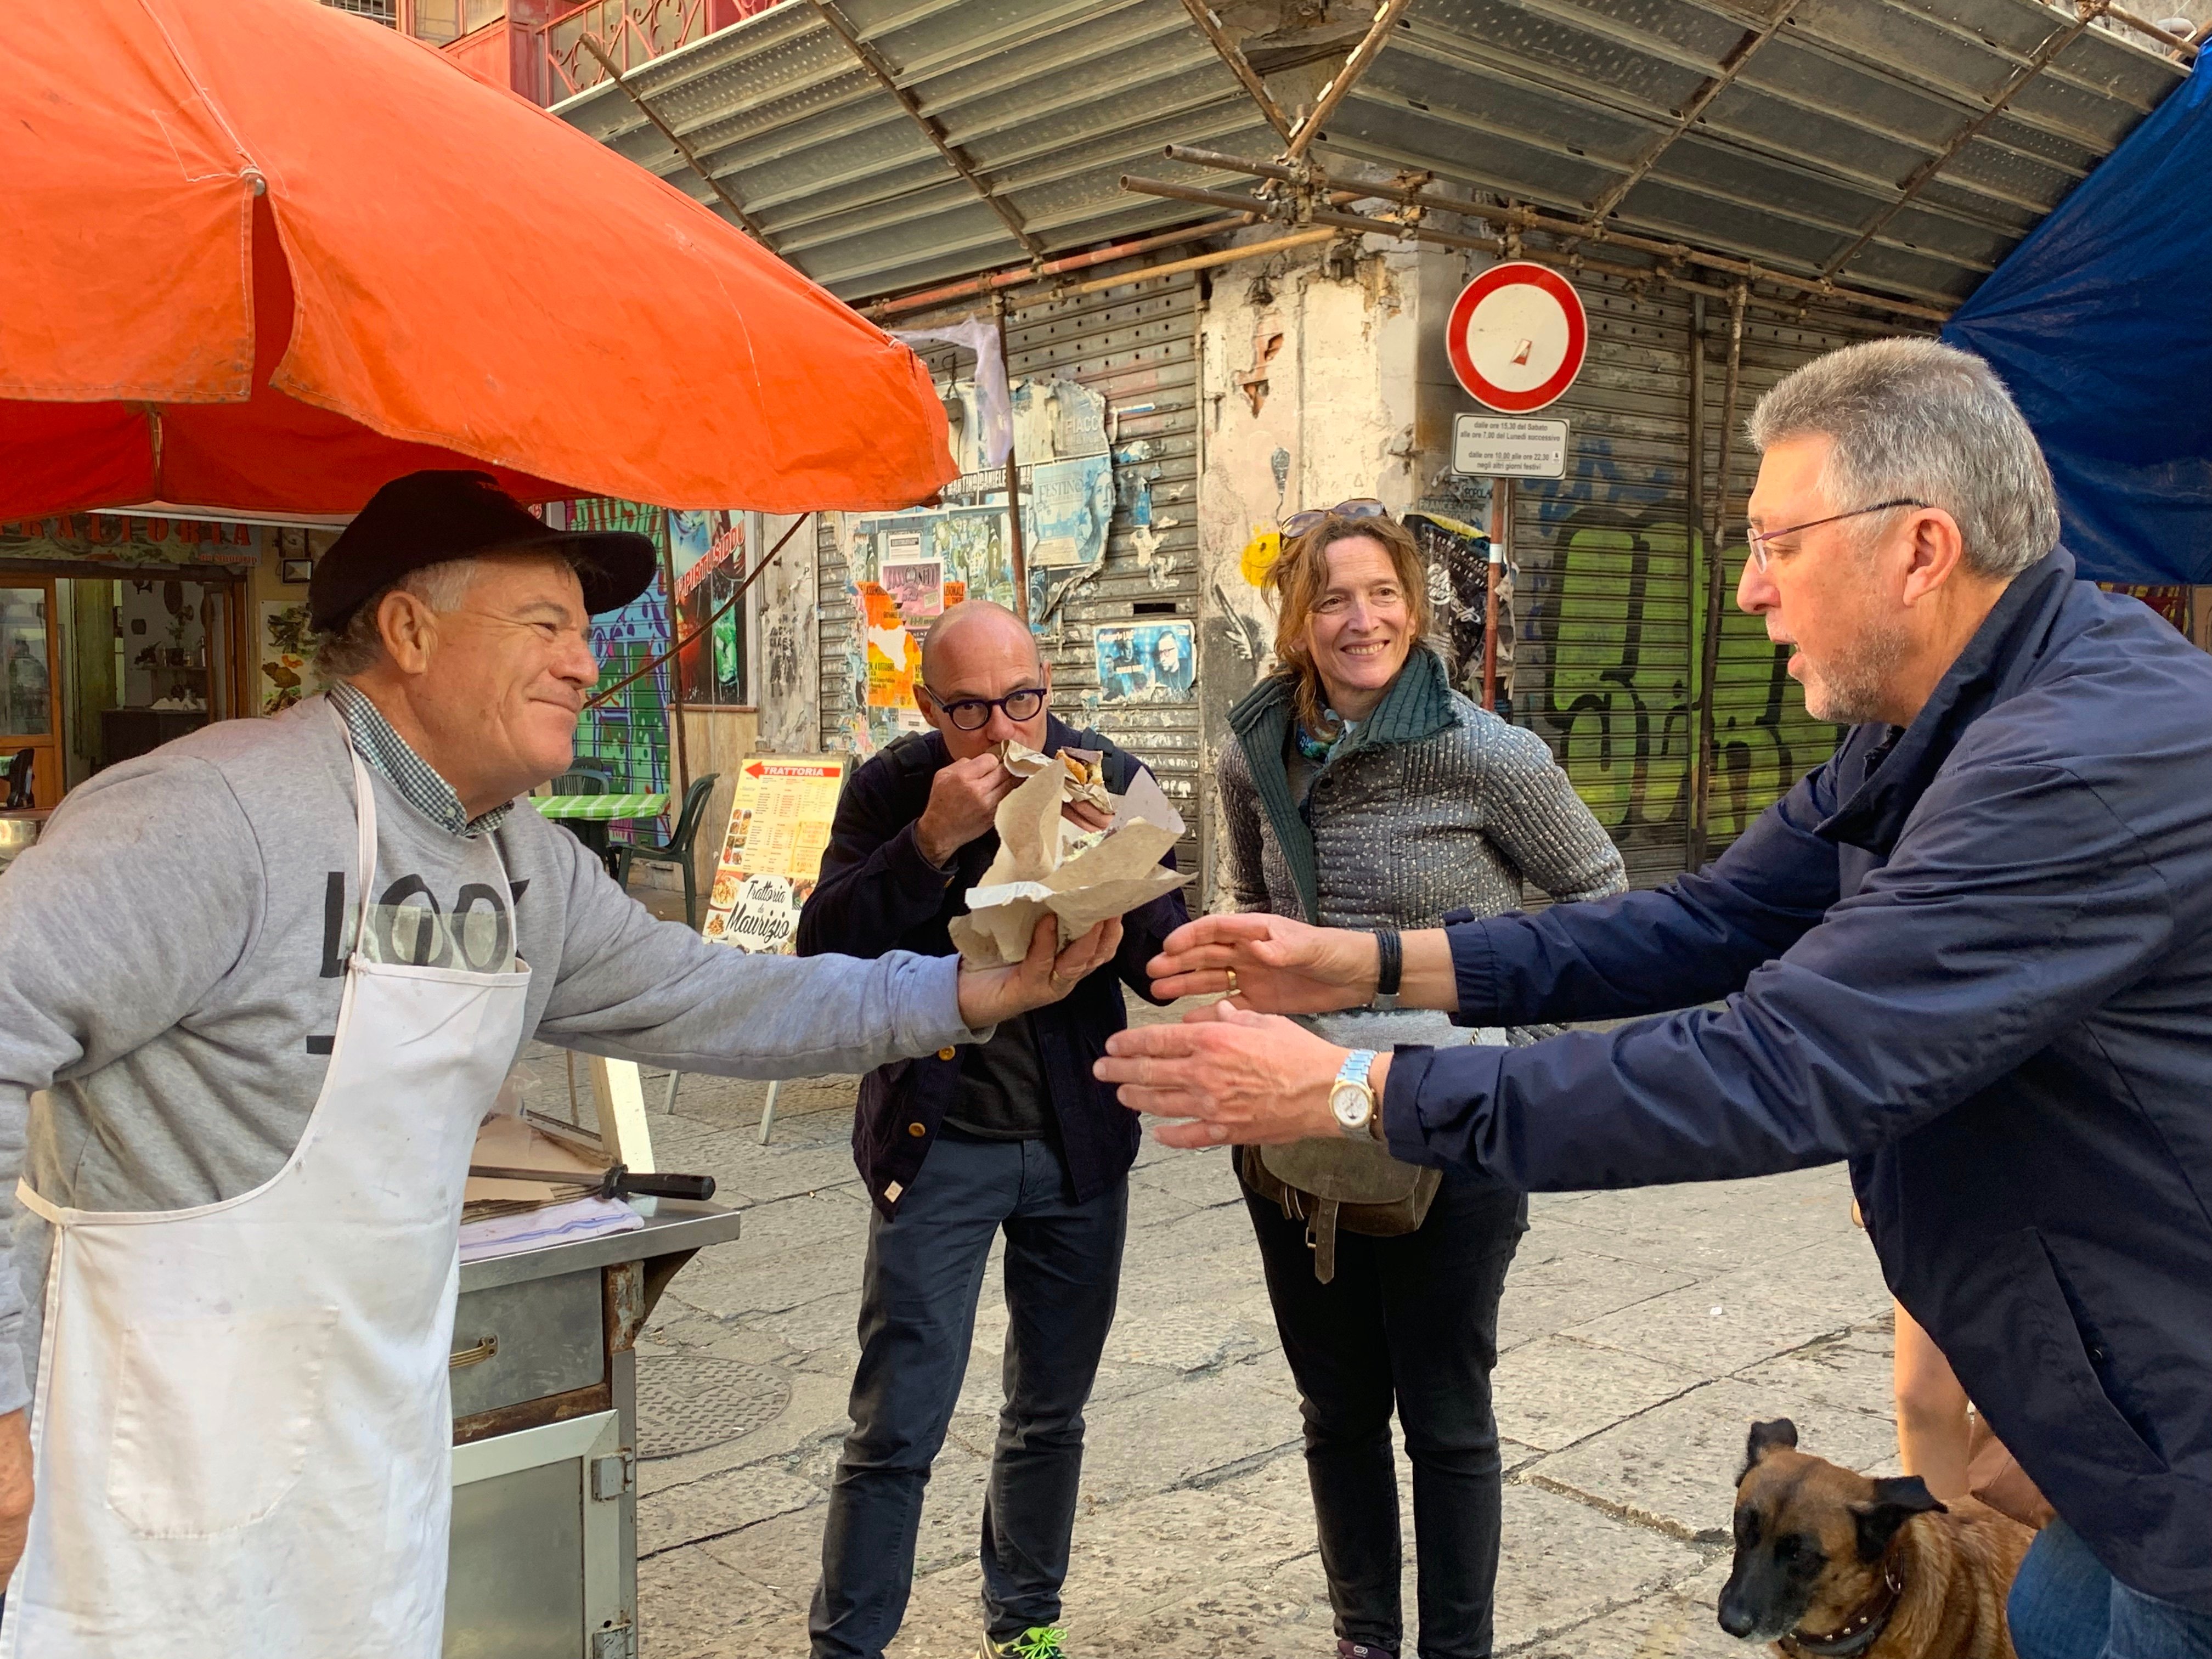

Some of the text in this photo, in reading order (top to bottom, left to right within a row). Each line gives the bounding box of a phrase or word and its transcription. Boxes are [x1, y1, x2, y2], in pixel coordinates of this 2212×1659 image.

[1528, 423, 1548, 431] Sabato
[1528, 433, 1560, 442] successivo
[1477, 461, 1491, 470] negli
[1505, 462, 1522, 471] giorni
[1039, 478, 1084, 504] FESTINO
[763, 766, 825, 777] TRATTORIA
[746, 879, 786, 904] Trattoria
[725, 901, 791, 944] Maurizio
